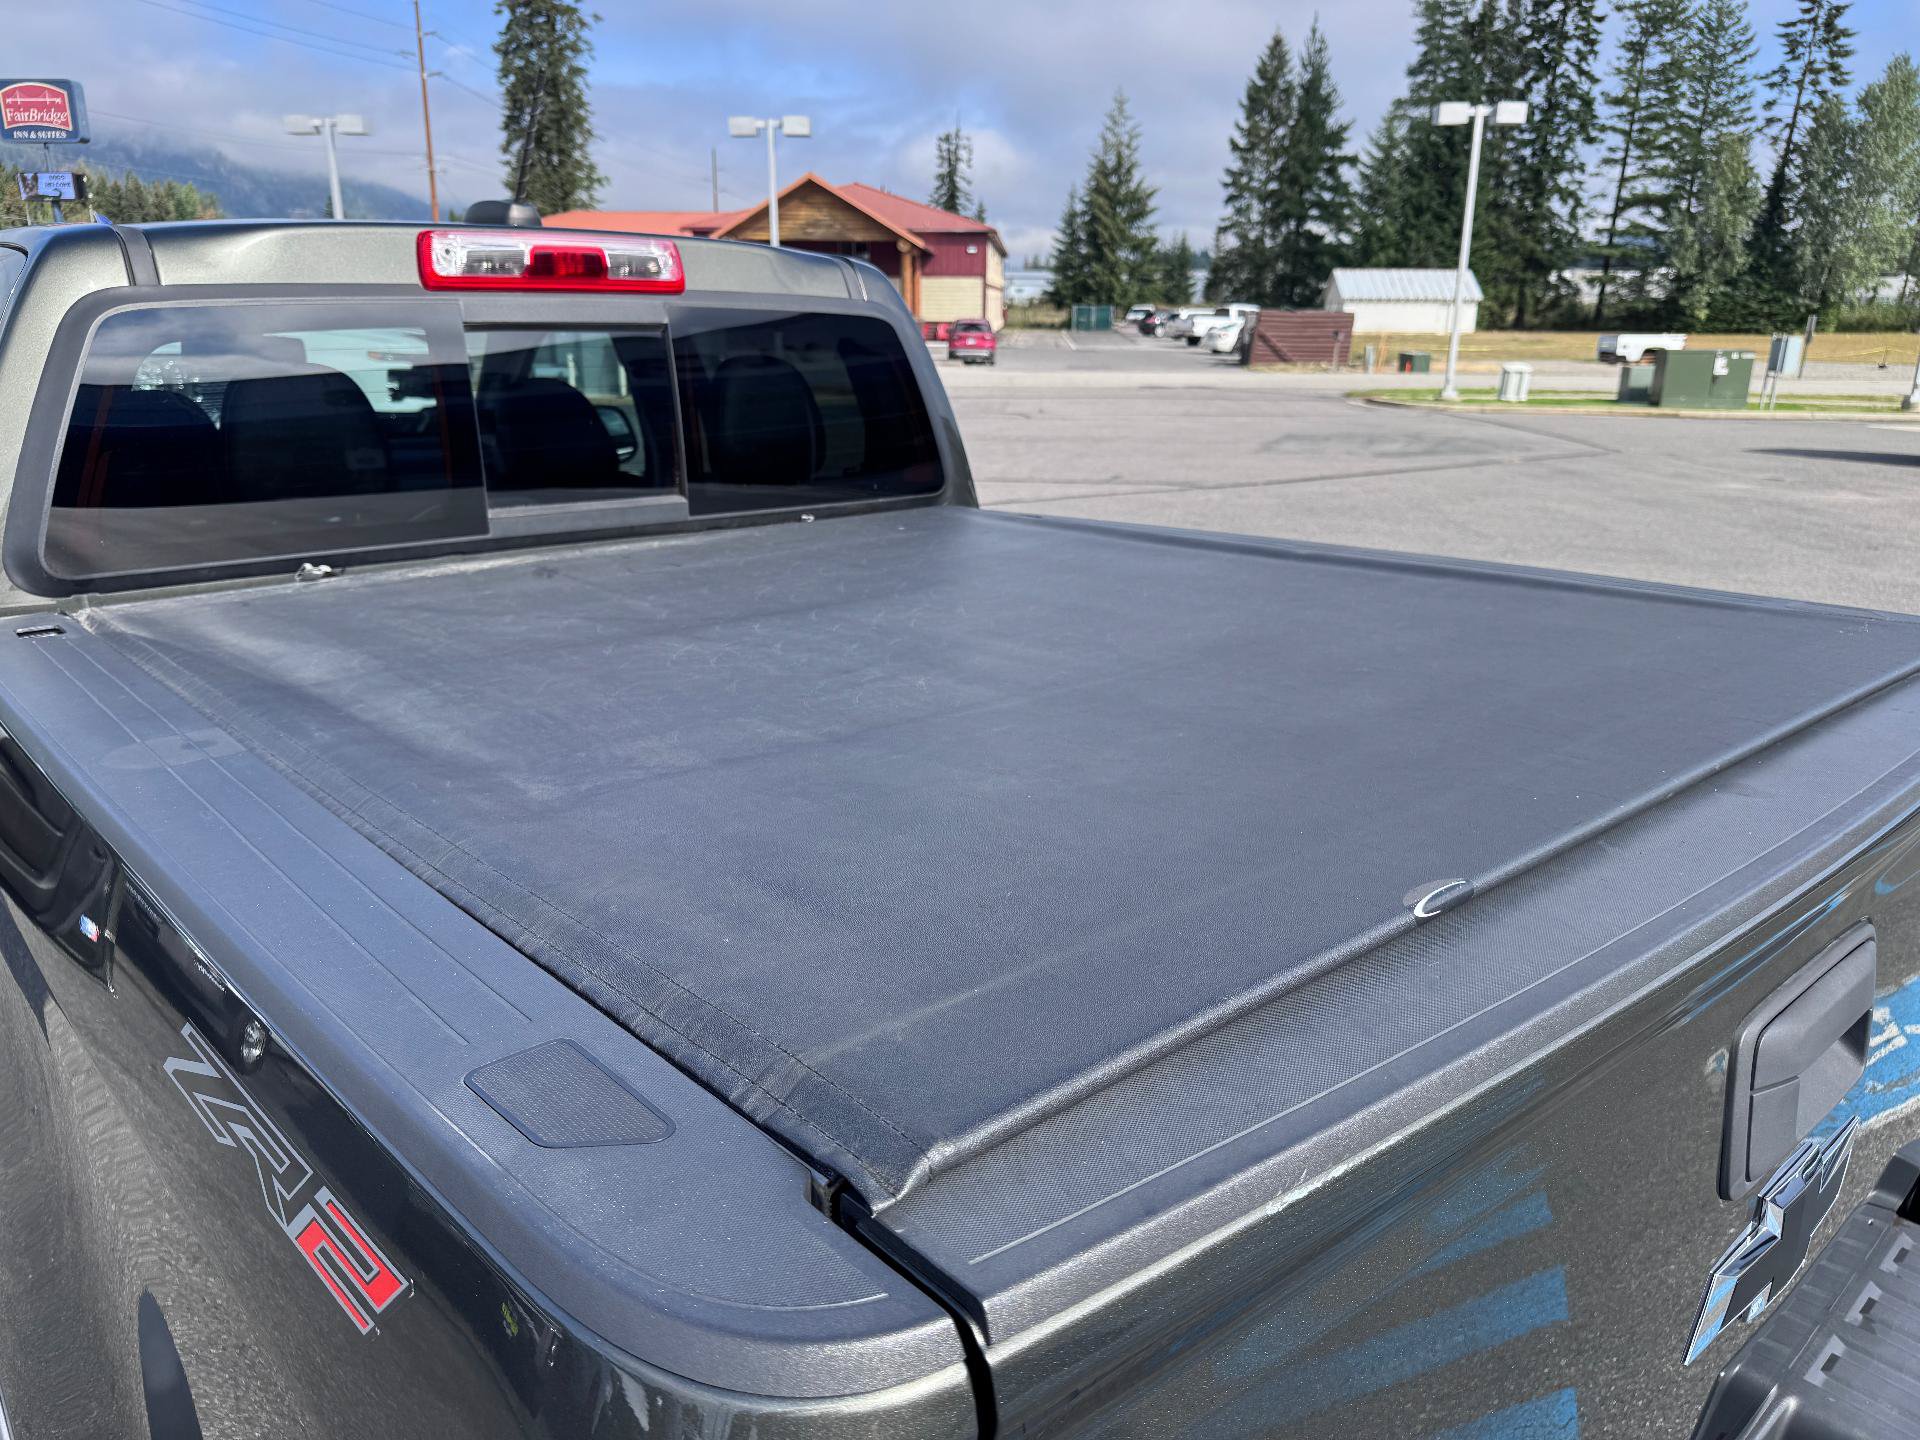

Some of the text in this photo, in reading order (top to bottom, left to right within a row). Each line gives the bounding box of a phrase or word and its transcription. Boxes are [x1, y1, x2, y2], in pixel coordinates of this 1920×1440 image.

[6, 108, 68, 125] FairBridge
[13, 131, 67, 139] INN & SUITES
[163, 1021, 410, 1335] ZR2
